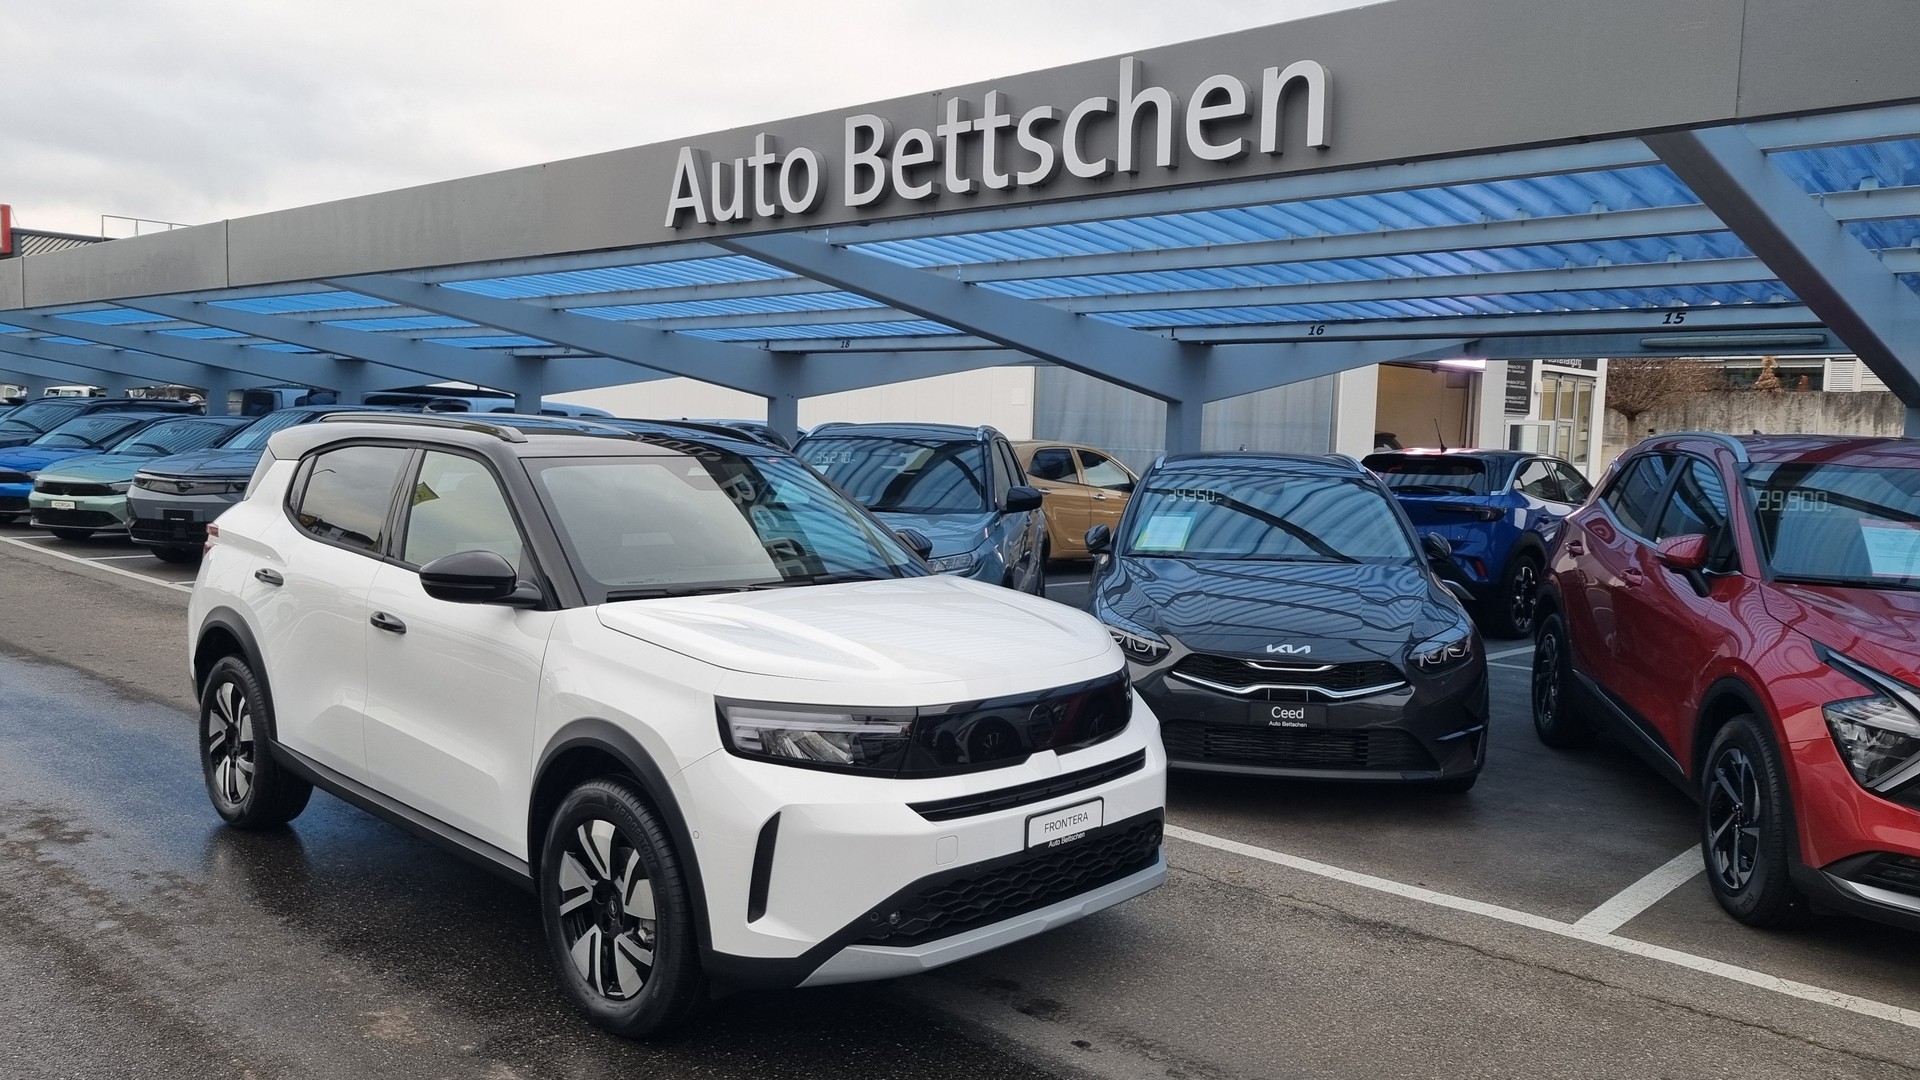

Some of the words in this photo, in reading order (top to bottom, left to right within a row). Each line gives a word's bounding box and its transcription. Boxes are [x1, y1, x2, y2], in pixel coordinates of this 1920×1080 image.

[665, 133, 823, 229] Auto
[845, 56, 1332, 208] Bettschen
[1662, 312, 1687, 325] 15
[1308, 325, 1325, 336] 16
[840, 340, 851, 349] 18
[1271, 706, 1305, 719] Ceed
[1044, 812, 1089, 834] FRONTERA
[1048, 839, 1061, 849] Auto
